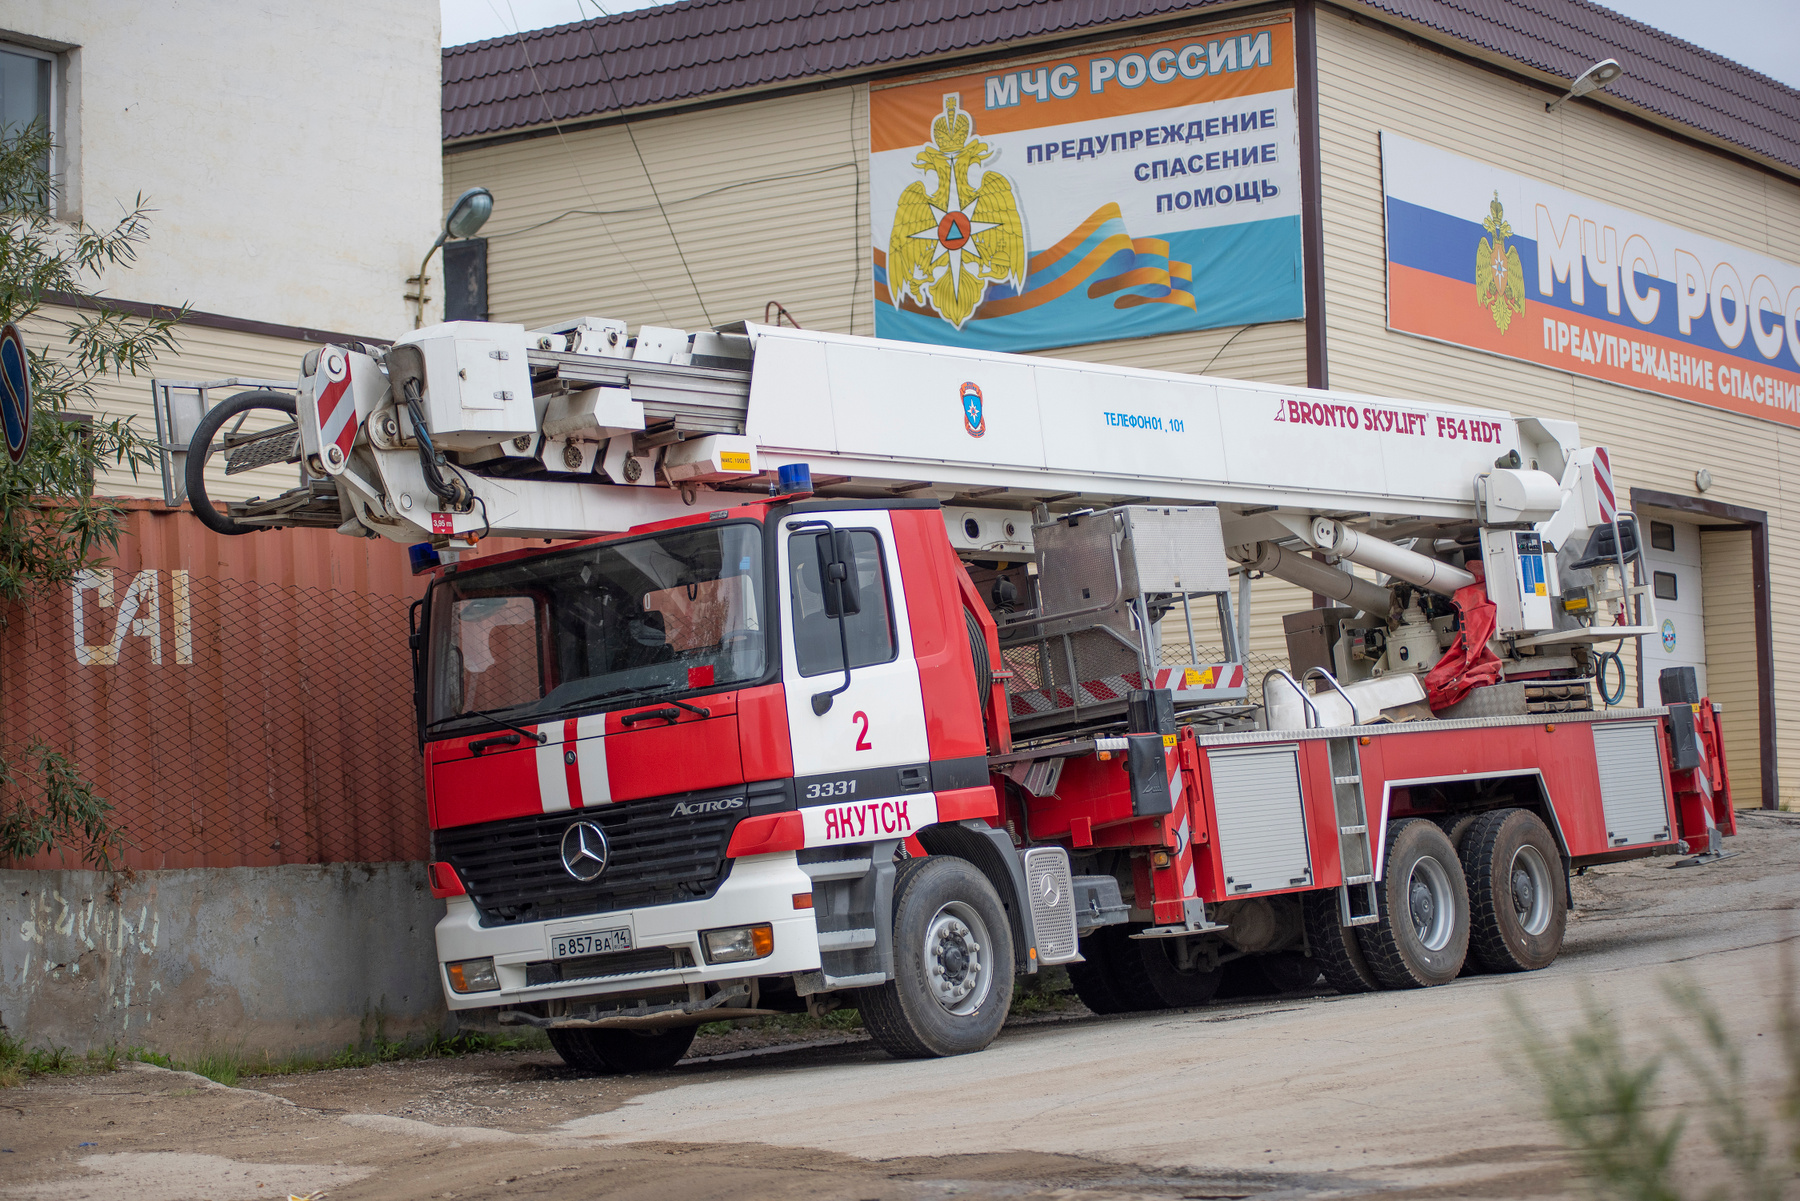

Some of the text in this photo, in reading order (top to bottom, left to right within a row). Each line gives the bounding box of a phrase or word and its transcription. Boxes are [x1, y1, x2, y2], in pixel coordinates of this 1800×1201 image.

[985, 30, 1273, 110] МЧС РОССИИ
[1026, 108, 1276, 164] ПРЕДУПРЕЖДЕНИЕ
[1134, 143, 1277, 182] СПАСЕНИЕ
[1156, 178, 1279, 214] ПОМОЩЬ
[1535, 203, 1661, 325] МЧС
[1542, 317, 1714, 392] ПРЕДУПРЕЖДЕНИЕ
[1168, 418, 1185, 433] 101
[1287, 399, 1359, 430] BRONTO
[433, 519, 446, 528] 3,95
[852, 710, 873, 752] 2
[806, 779, 857, 799] 3331
[824, 800, 912, 840] ЯКУТСК
[614, 931, 627, 944] 14
